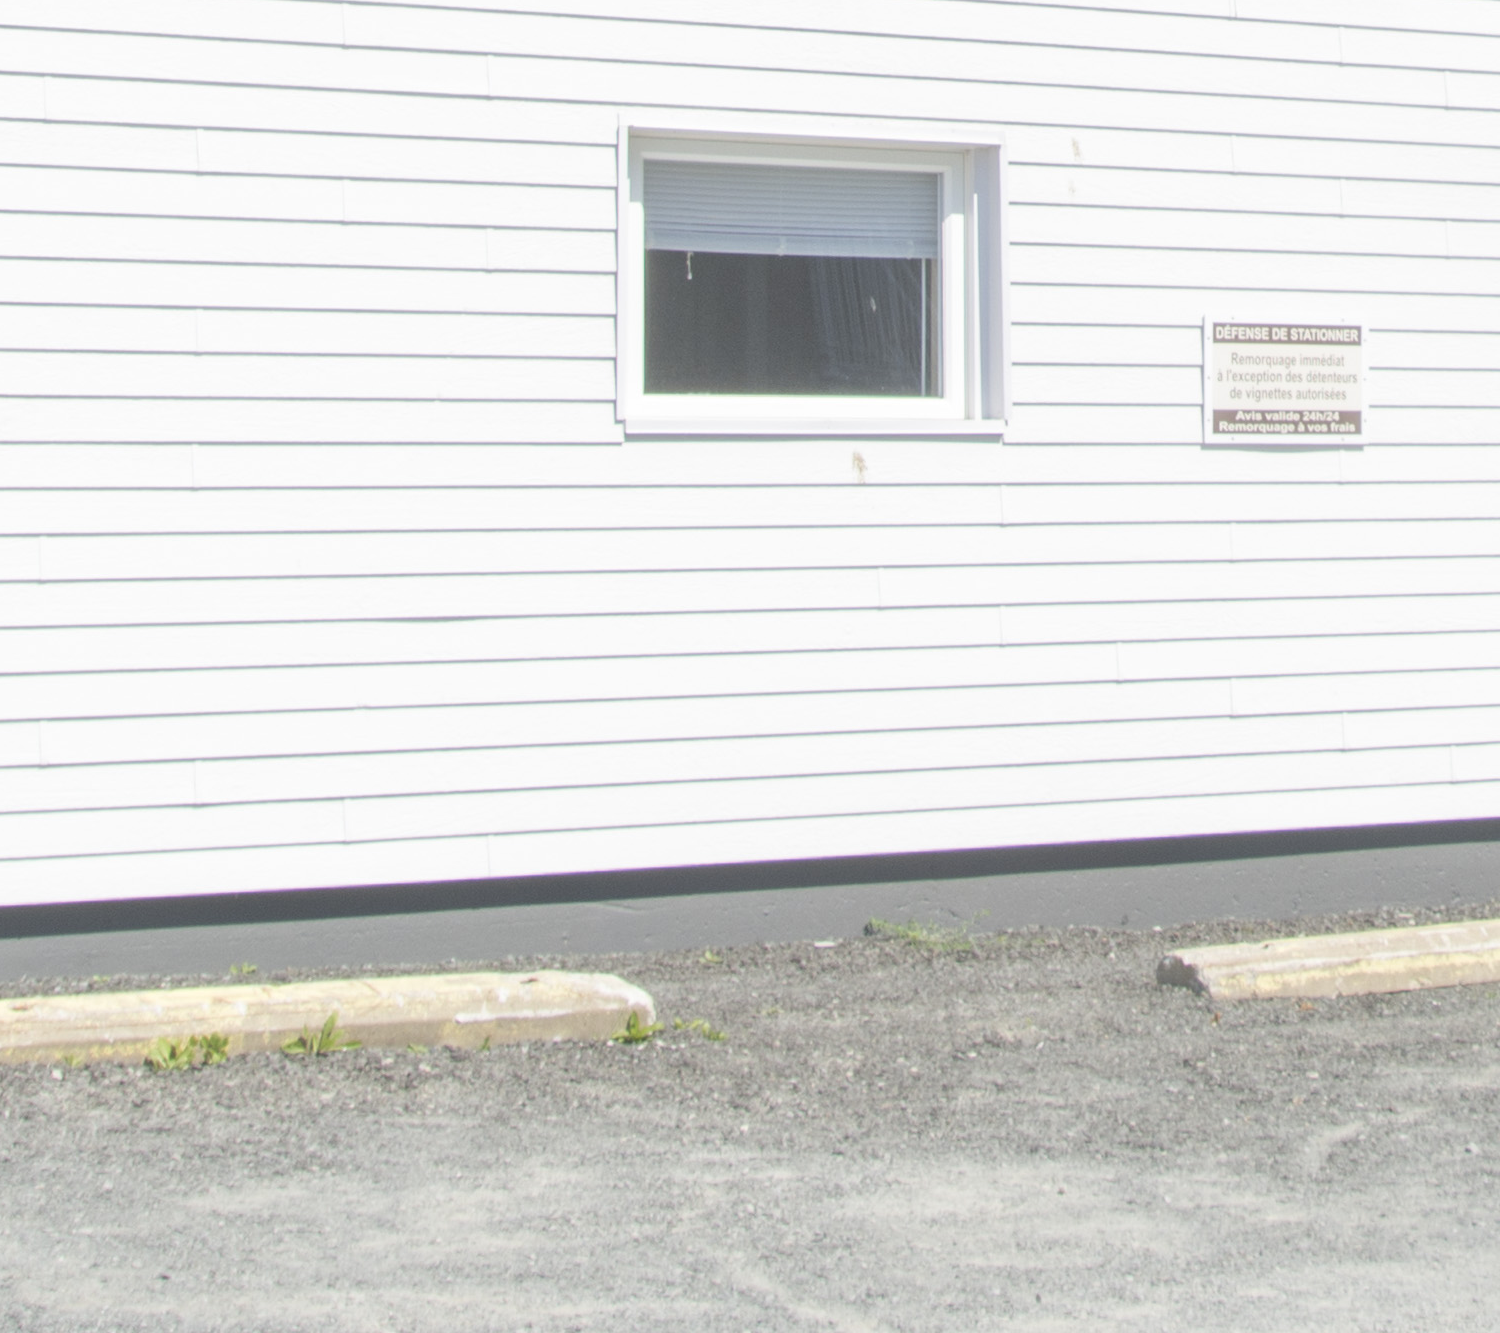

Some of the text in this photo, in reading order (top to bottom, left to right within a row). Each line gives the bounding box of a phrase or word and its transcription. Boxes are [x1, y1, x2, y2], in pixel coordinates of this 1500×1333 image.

[1216, 325, 1358, 342] DÉFENSE DE STATIONNER
[1231, 352, 1344, 369] Remorquage immédiat
[1217, 370, 1358, 385] à l'exception des détenteurs
[1230, 387, 1347, 402] de vignettes autorisées
[1235, 411, 1340, 421] Avis valide 24h/24
[1219, 422, 1295, 433] Remorquage
[1297, 422, 1305, 432] à
[1330, 423, 1355, 432] frais
